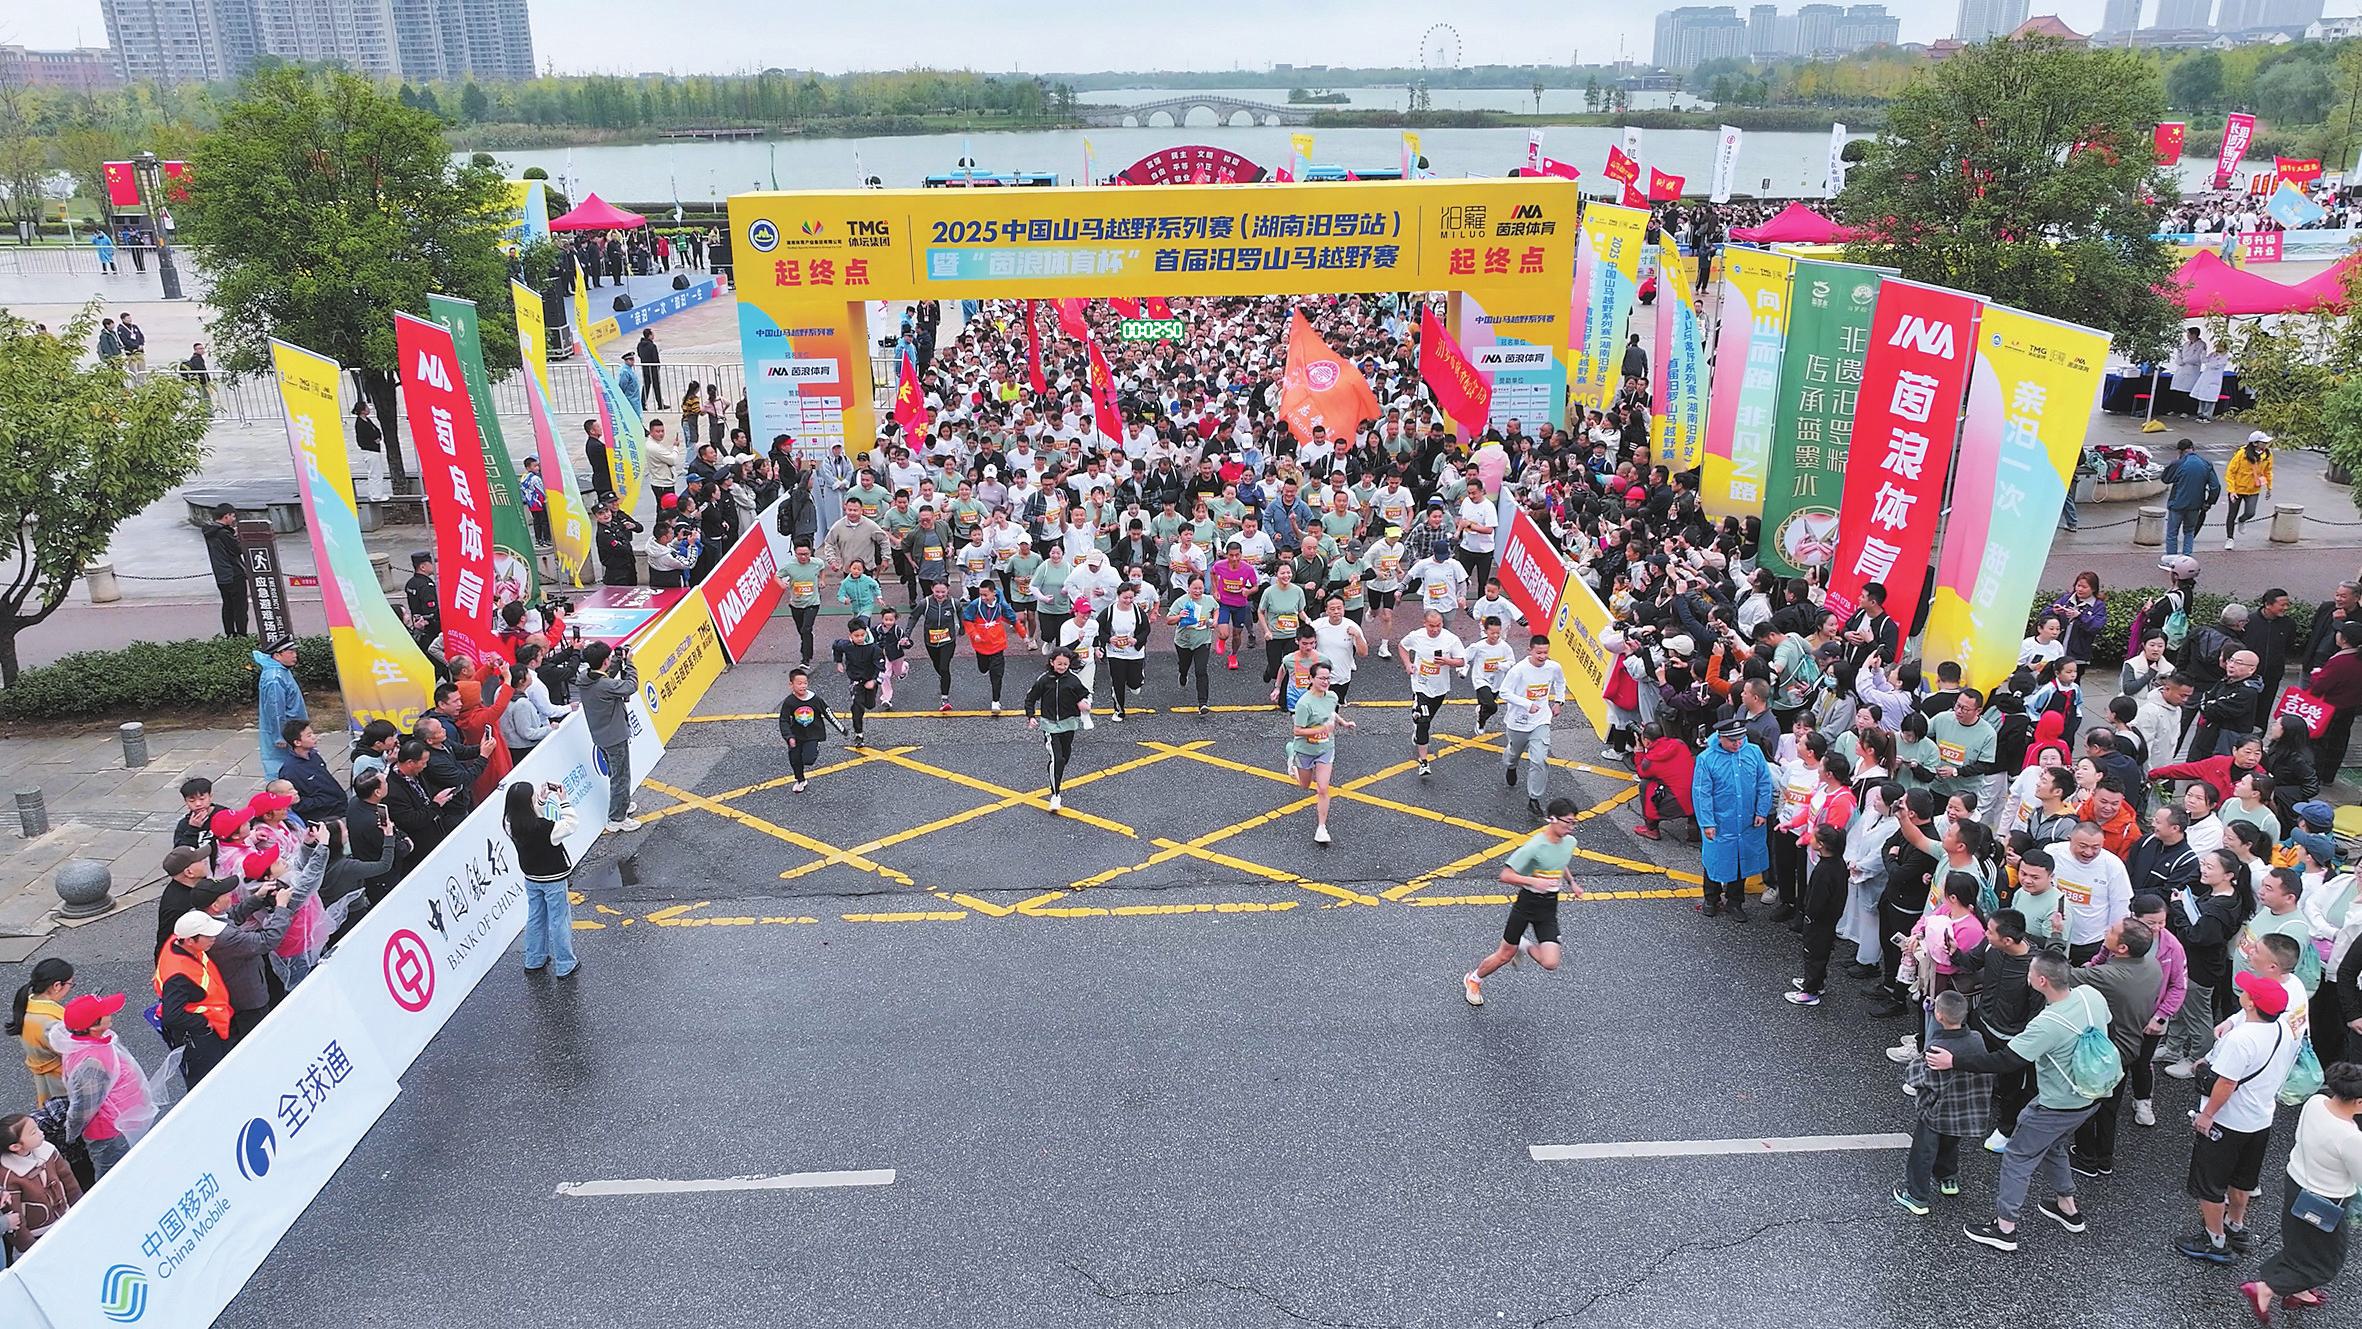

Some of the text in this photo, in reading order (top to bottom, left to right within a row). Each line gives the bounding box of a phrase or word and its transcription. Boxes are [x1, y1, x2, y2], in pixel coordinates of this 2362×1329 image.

[1171, 150, 1187, 160] 民主
[1197, 150, 1214, 160] 文明
[1150, 168, 1166, 181] 自由
[1172, 162, 1189, 172] 平等
[847, 220, 889, 235] TMG
[1441, 205, 1486, 229] 汨羅
[1511, 205, 1543, 219] INA
[848, 236, 890, 247] 体坛集团
[1496, 222, 1556, 237] 茵浪体育
[775, 258, 870, 286] 起终点
[1449, 246, 1545, 275] 起终点
[755, 328, 834, 338] 中国山马越野系列赛
[1475, 314, 1555, 324] 中国山马越野系列赛
[1744, 288, 1781, 389] 向山而跑
[1888, 314, 1955, 360] INA
[2029, 345, 2047, 354] TMG
[768, 368, 788, 376] INA
[791, 366, 830, 376] 茵浪体育
[1480, 354, 1502, 363] INA
[1505, 353, 1545, 363] 茵浪体育
[1662, 358, 1678, 459] 首届汨罗山马越野赛
[1792, 353, 1830, 497] 传承蓝墨水
[1995, 380, 2048, 518] 亲汨一次
[1852, 369, 1939, 586] 茵浪体育
[1505, 535, 1526, 577] INA
[736, 547, 777, 606] 茵浪体育
[1519, 553, 1557, 619] 茵浪体育
[255, 576, 278, 642] 应急避难场所
[268, 577, 280, 610] EMERGENCY
[718, 588, 746, 637] INA
[697, 620, 711, 640] TMG
[660, 645, 703, 702] 中国山马越野系列赛
[1565, 628, 1603, 688] 中国山马越野系列赛
[1942, 749, 1960, 759] 6827
[561, 763, 587, 795] 国移动
[427, 837, 509, 942] 中国银行
[447, 884, 524, 971] BANK OF CHINA
[276, 1039, 354, 1140] 全球通
[141, 1171, 220, 1260] 中国移动
[157, 1196, 231, 1280] China Mobile
